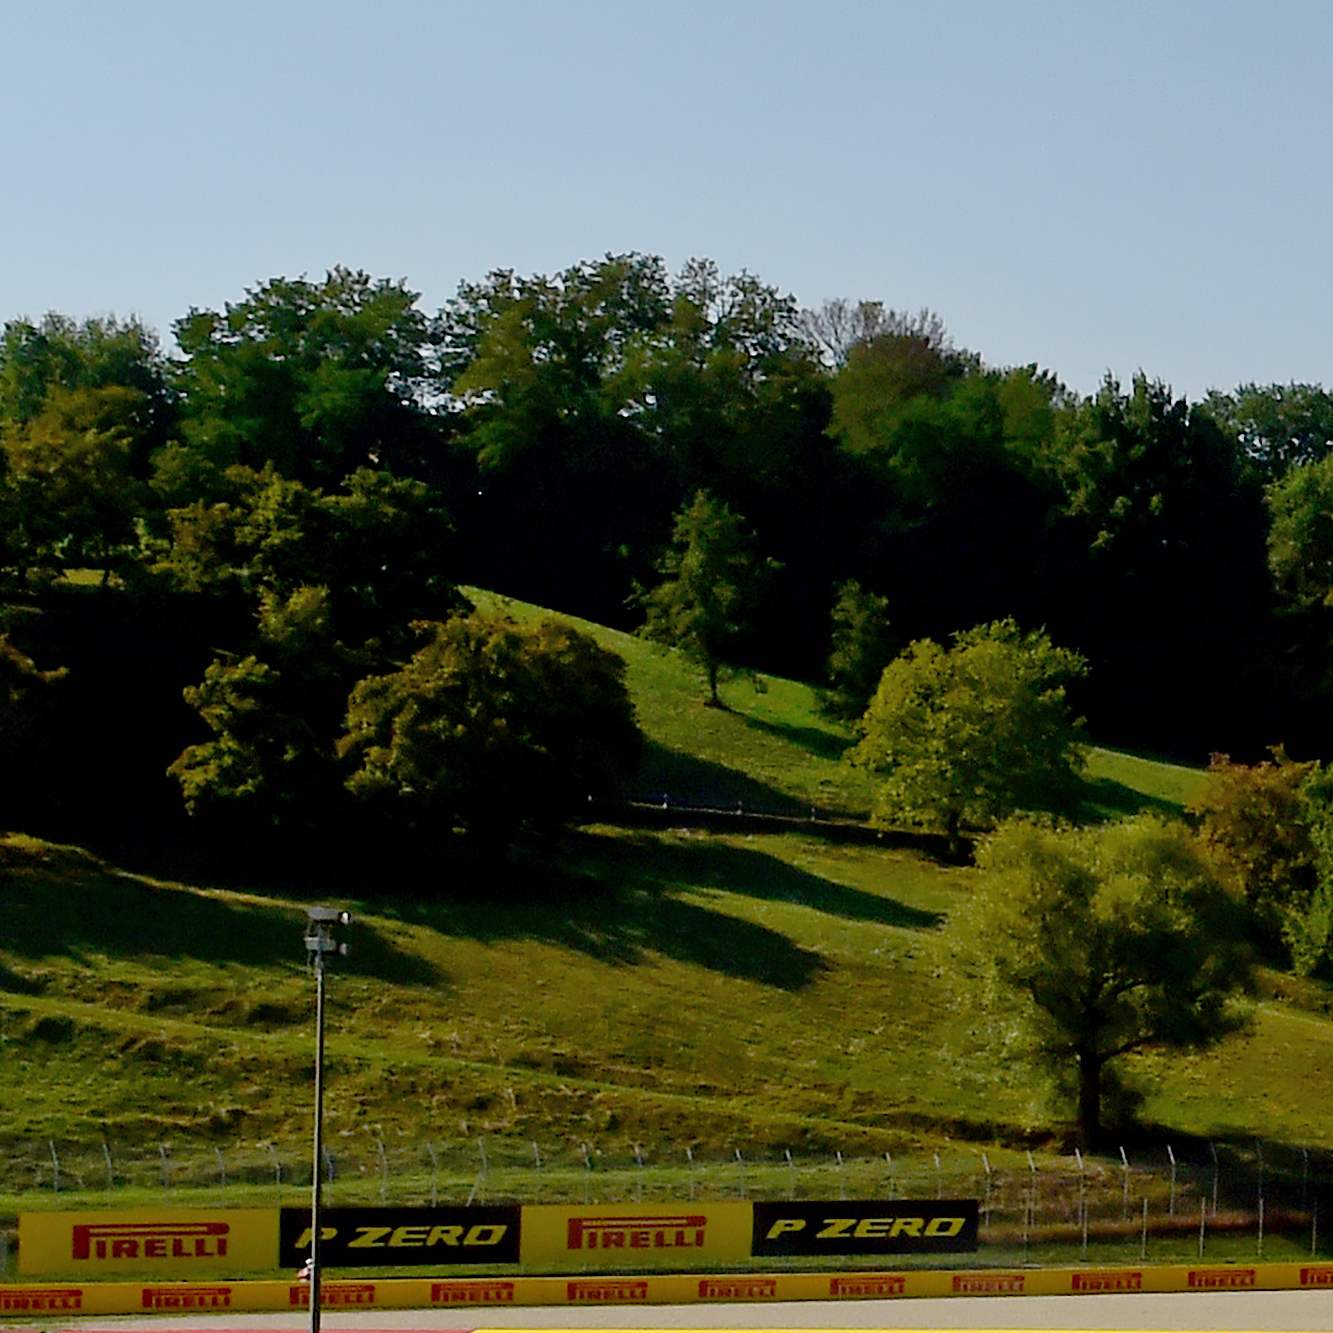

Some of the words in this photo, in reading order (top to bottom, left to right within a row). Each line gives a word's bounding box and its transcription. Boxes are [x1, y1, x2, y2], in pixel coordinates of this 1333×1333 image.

[294, 1227, 338, 1248] P
[347, 1225, 508, 1248] ZERO
[567, 1215, 707, 1249] PIRELLI
[765, 1218, 807, 1239] P
[815, 1217, 967, 1239] ZERO
[72, 1222, 230, 1260] PIRELLI
[142, 1287, 232, 1308] PIRELLI
[431, 1282, 515, 1302] PIRELLI
[566, 1281, 648, 1301] PIRELLI
[698, 1279, 777, 1299] PIRELLI
[829, 1277, 906, 1297] PIRELLI
